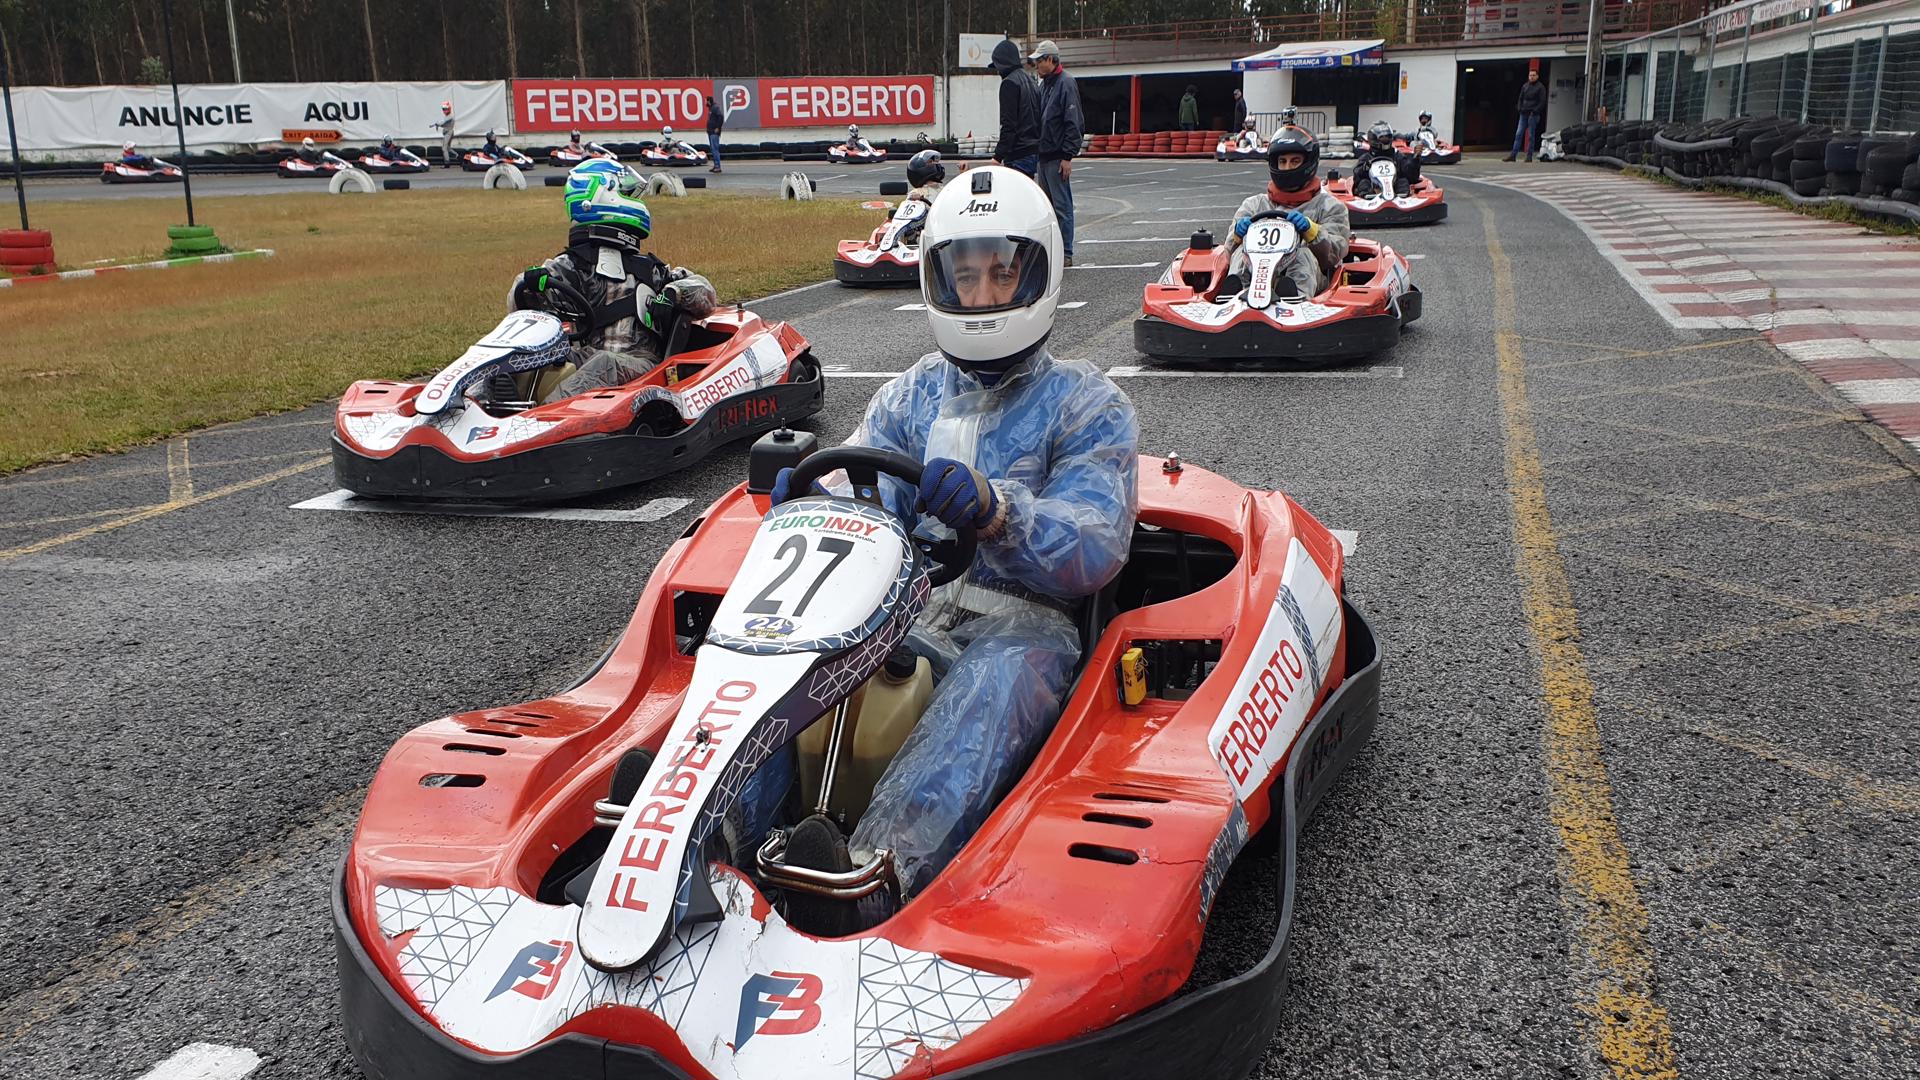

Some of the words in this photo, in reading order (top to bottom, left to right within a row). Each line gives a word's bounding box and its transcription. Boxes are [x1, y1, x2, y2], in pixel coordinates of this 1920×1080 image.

[118, 104, 253, 127] ANUNCIE
[304, 101, 369, 123] AQUI
[526, 87, 704, 123] FERBERTO
[771, 84, 926, 119] FERBERTO
[1378, 164, 1391, 175] 25
[903, 204, 916, 216] 16
[958, 199, 999, 216] Arai
[1258, 227, 1281, 247] 30
[1253, 258, 1271, 299] FERBERTO
[497, 319, 539, 340] 17
[685, 366, 750, 416] FERBERTO
[768, 515, 880, 536] EUROINDY
[743, 533, 855, 618] 27
[750, 617, 786, 632] 24
[606, 680, 757, 913] FERBERTO
